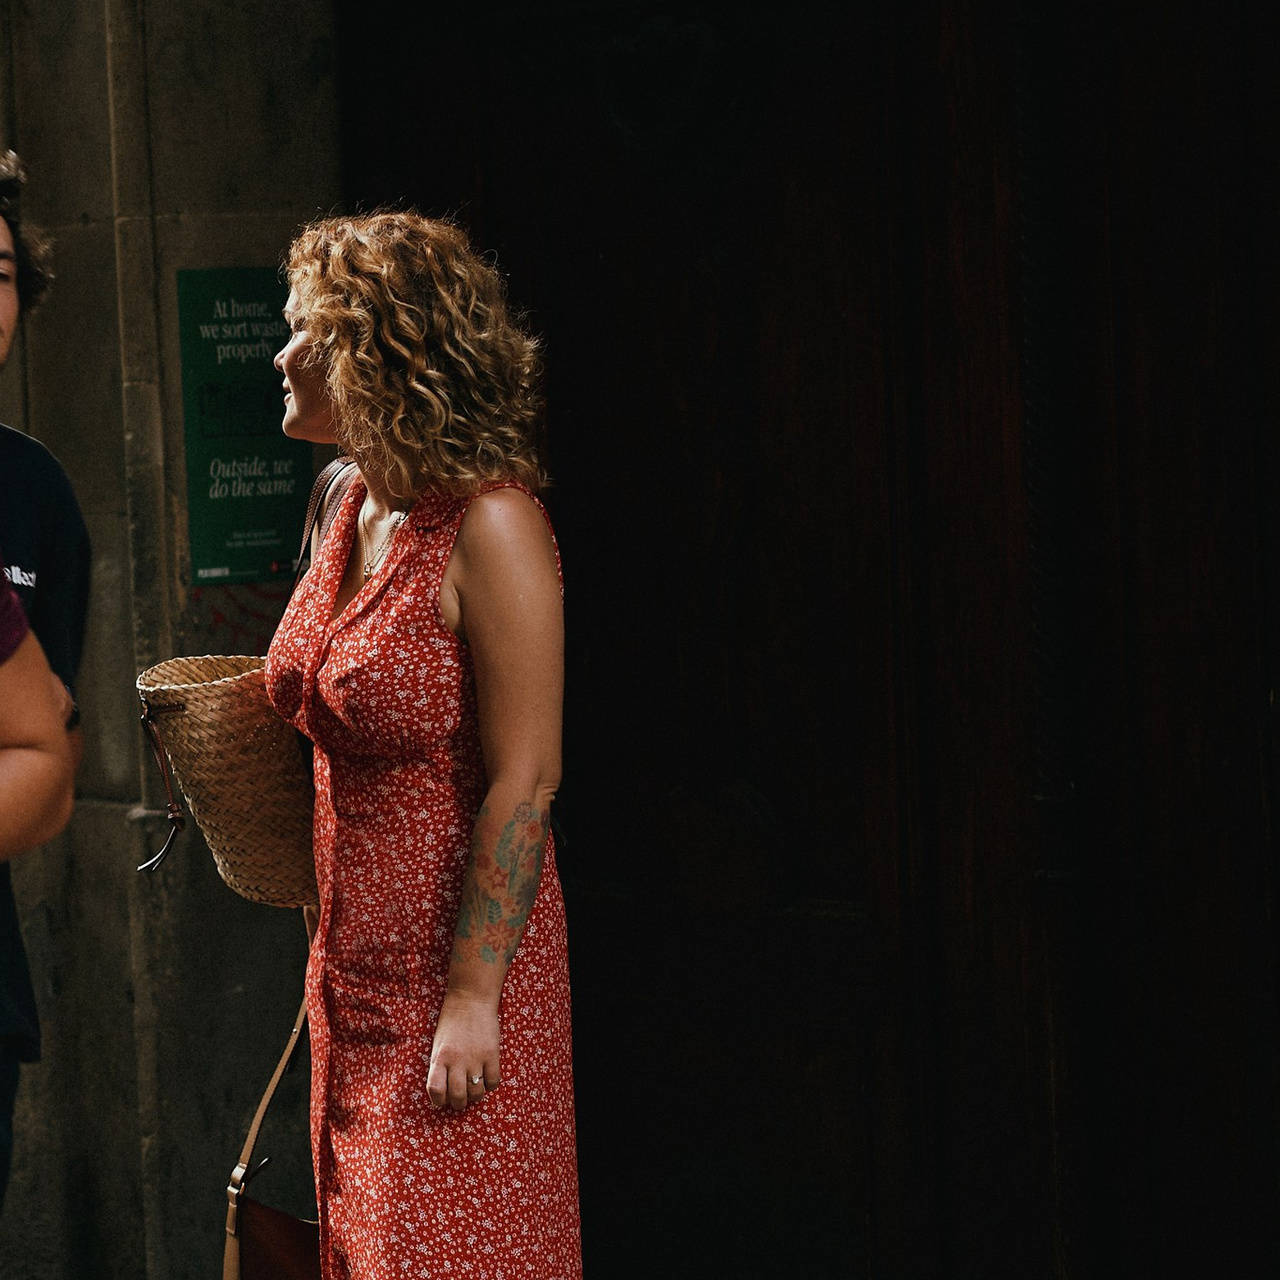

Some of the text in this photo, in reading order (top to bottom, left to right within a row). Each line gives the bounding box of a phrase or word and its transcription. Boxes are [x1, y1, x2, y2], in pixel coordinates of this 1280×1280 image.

[213, 298, 272, 319] At home,
[199, 322, 287, 339] we sort waste
[216, 342, 273, 364] properly
[209, 456, 293, 479] Outside, we
[209, 478, 296, 499] do the same
